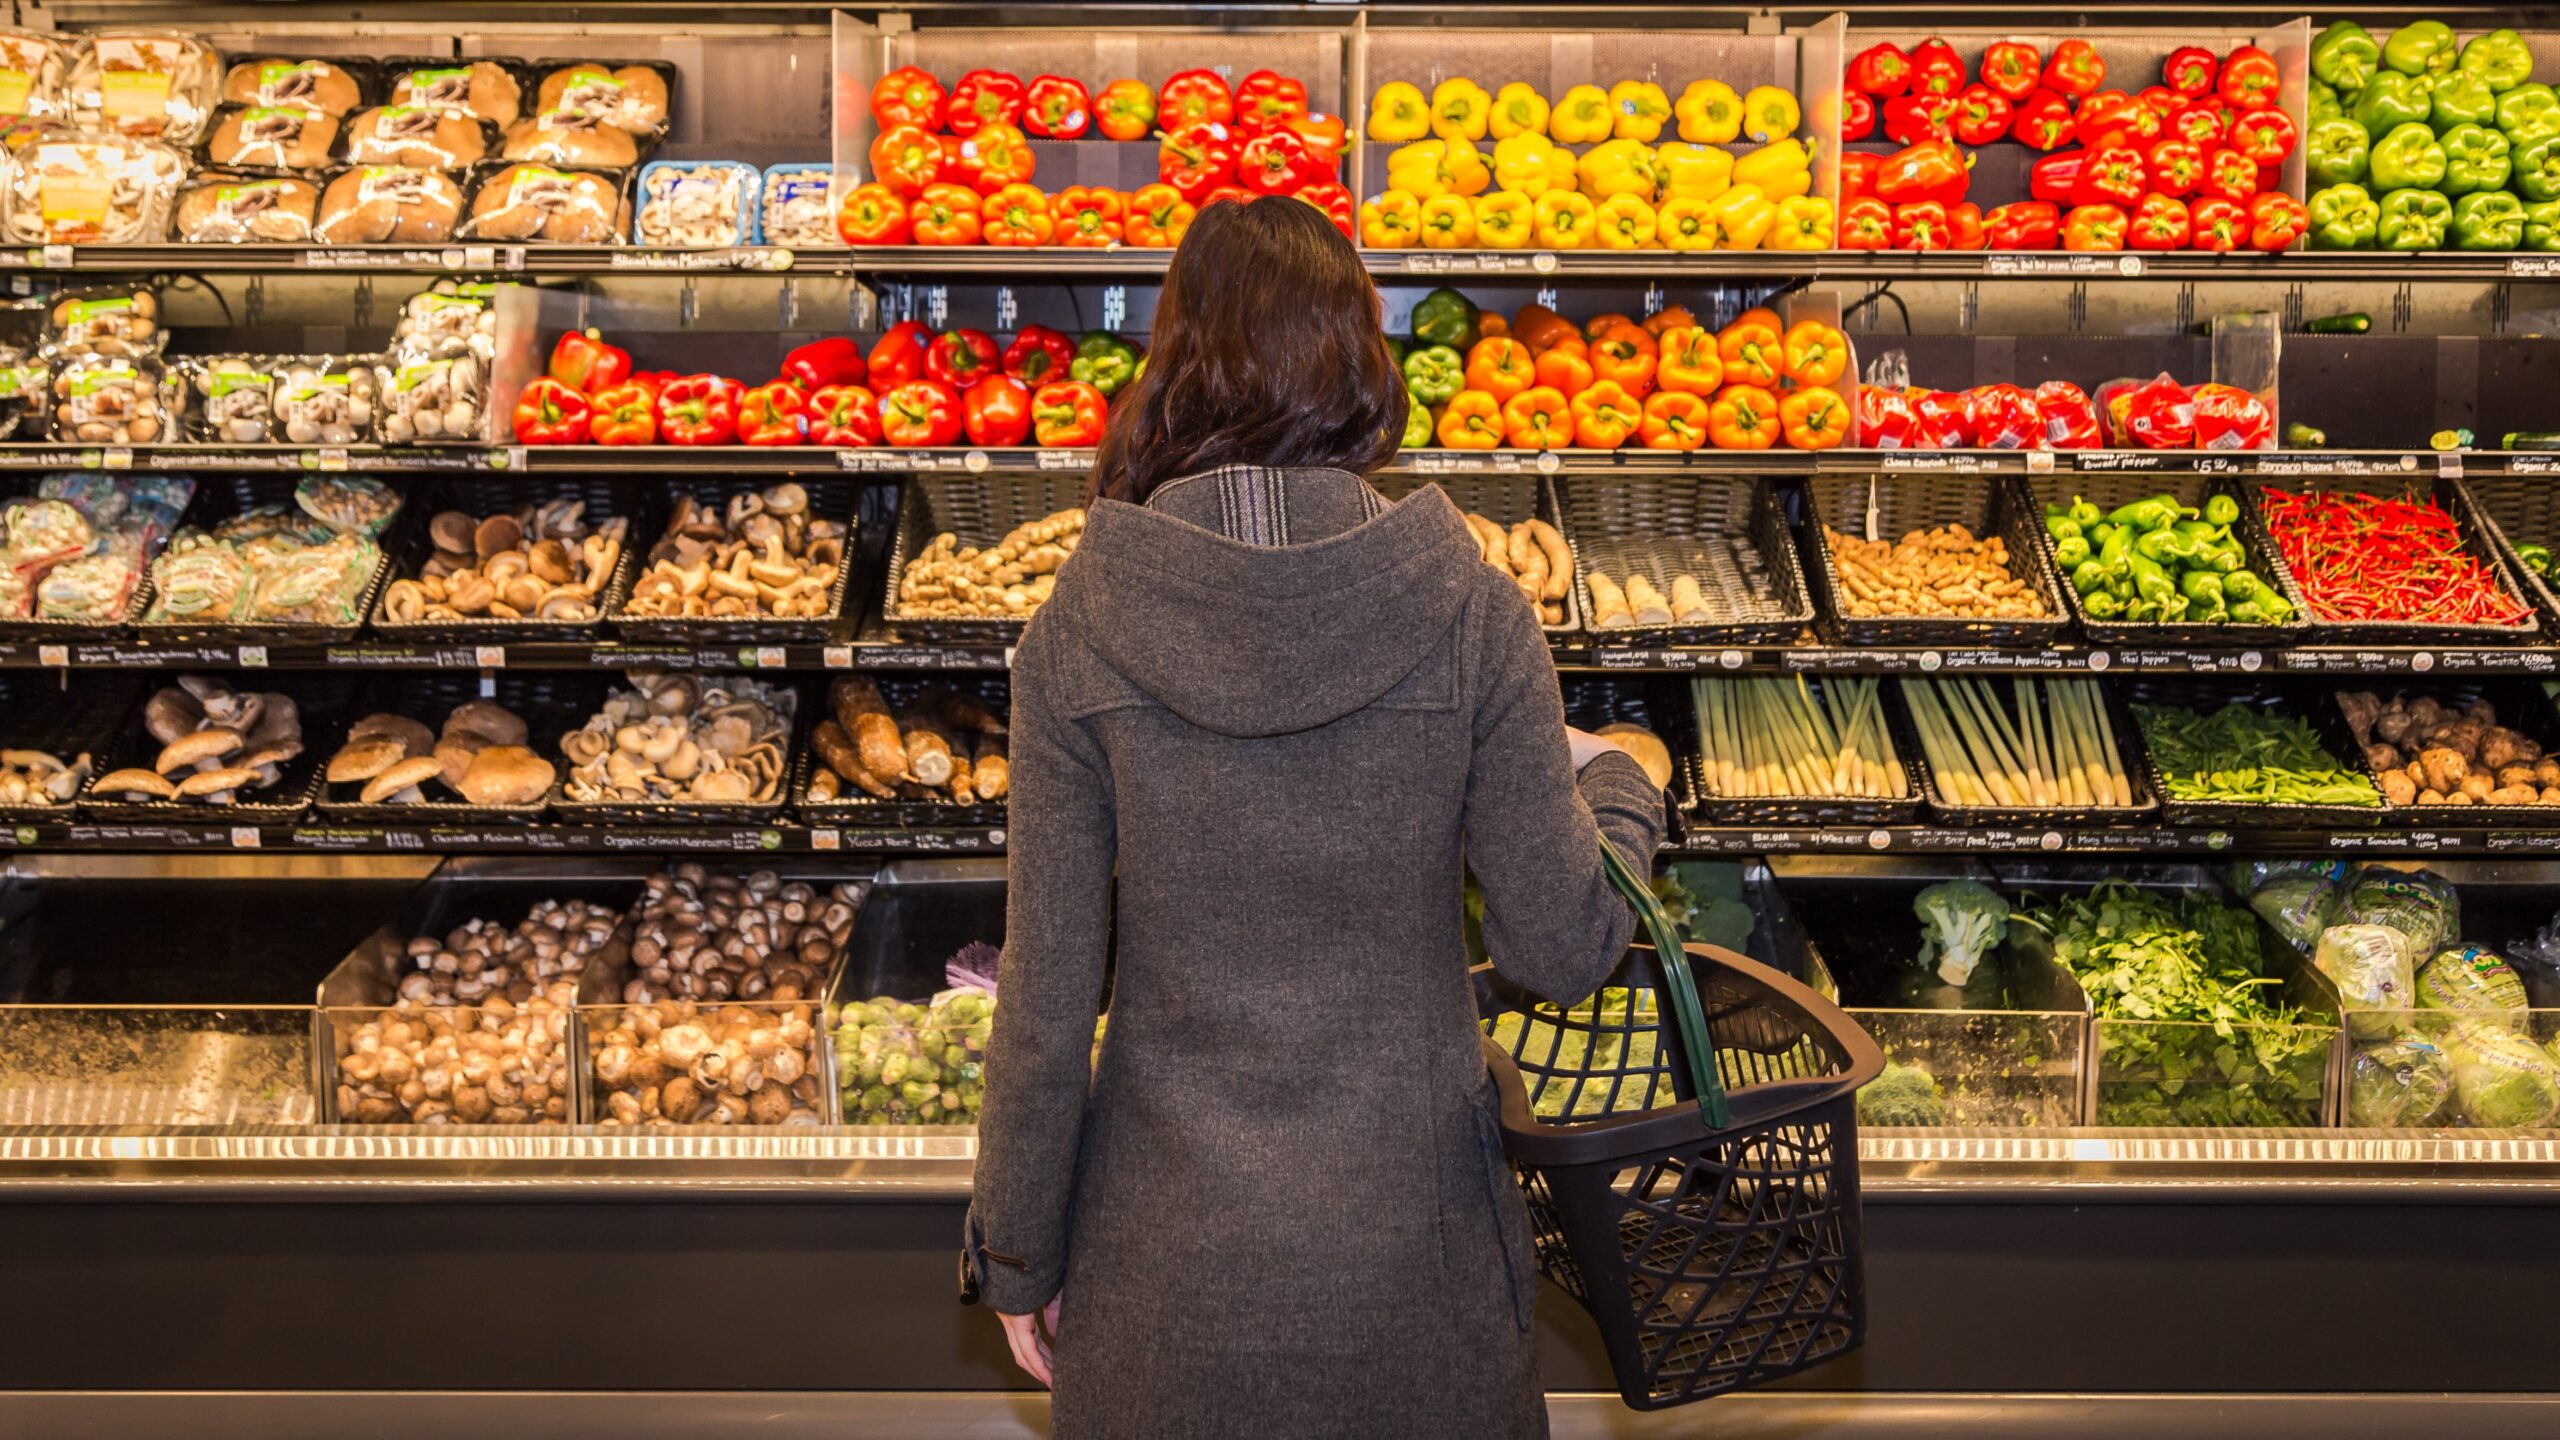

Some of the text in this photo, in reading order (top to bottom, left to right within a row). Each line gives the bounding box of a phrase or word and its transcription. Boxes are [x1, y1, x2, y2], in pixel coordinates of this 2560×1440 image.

[858, 654, 899, 667] Organic
[603, 836, 646, 850] Organic
[847, 836, 882, 849] Yucca
